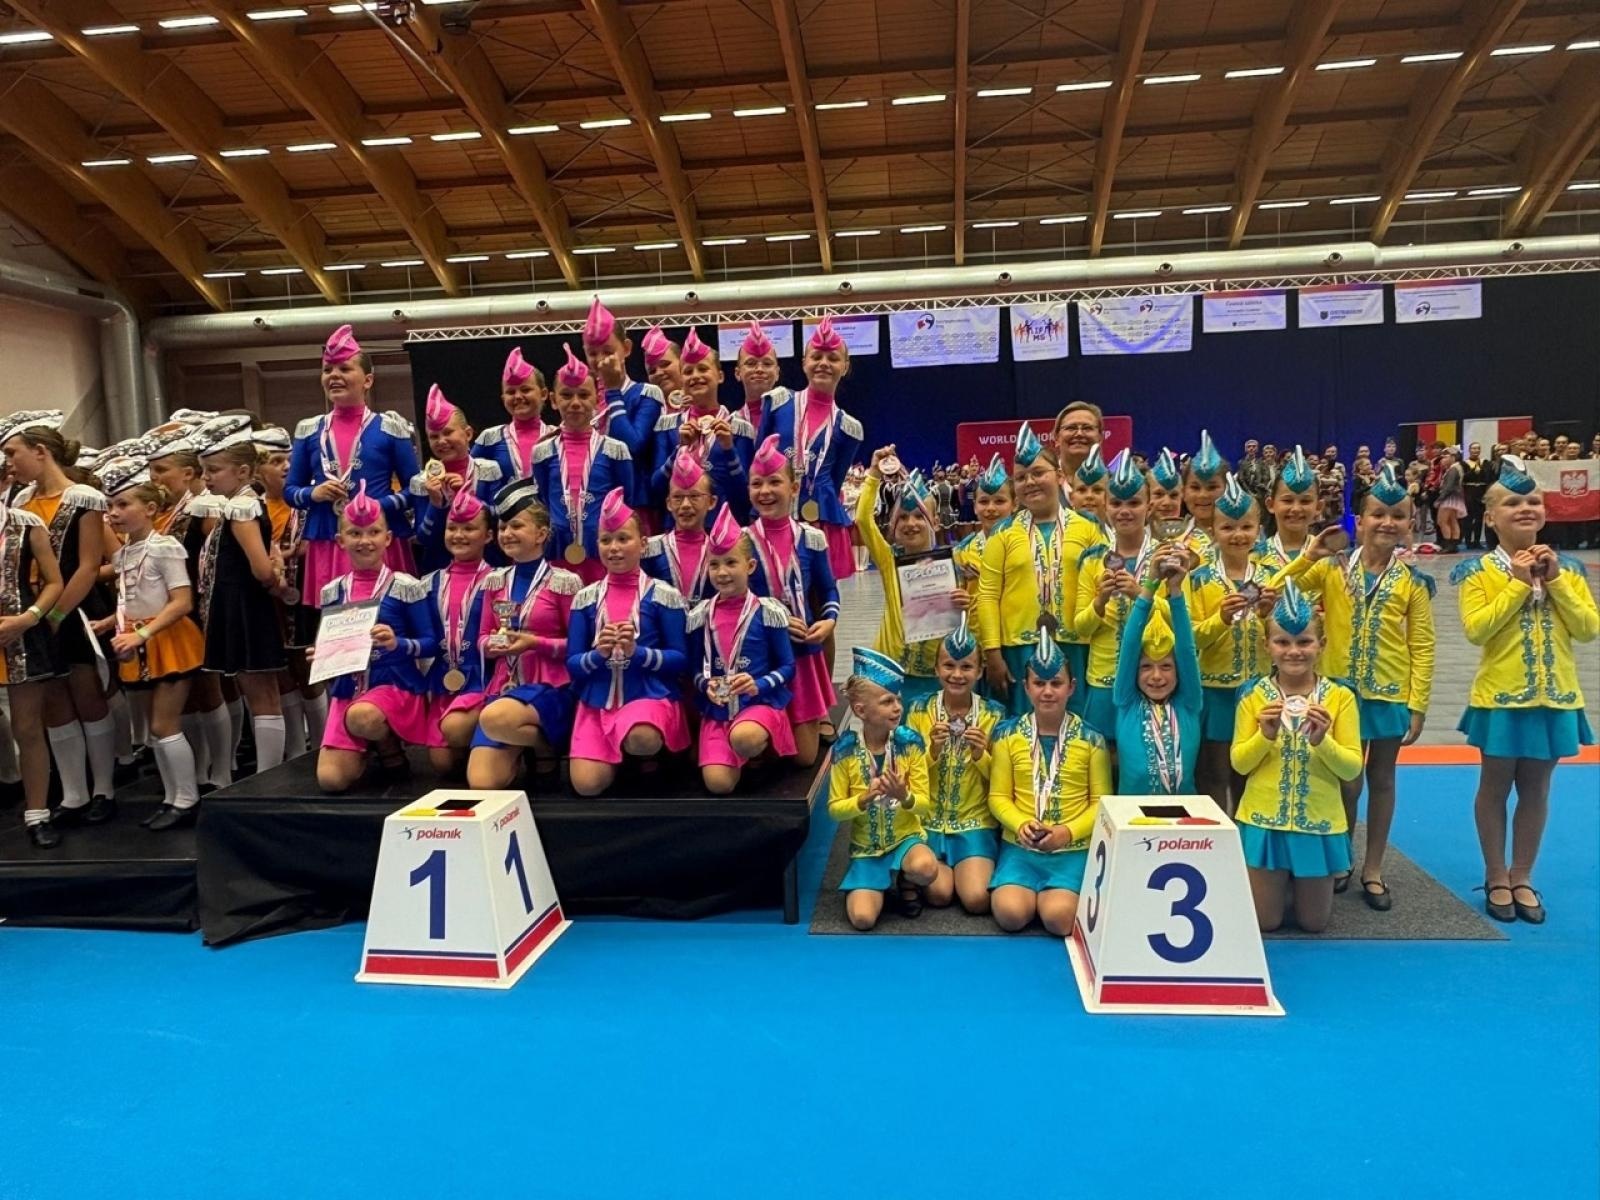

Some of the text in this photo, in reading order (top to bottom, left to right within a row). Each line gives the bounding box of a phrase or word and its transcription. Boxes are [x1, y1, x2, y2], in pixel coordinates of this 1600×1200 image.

[979, 435, 1017, 445] WORLD
[416, 827, 462, 841] polanik
[505, 830, 534, 915] 1
[1157, 837, 1215, 853] polanik
[410, 850, 446, 940] 1
[1087, 840, 1106, 933] 3
[1147, 862, 1214, 963] 3
